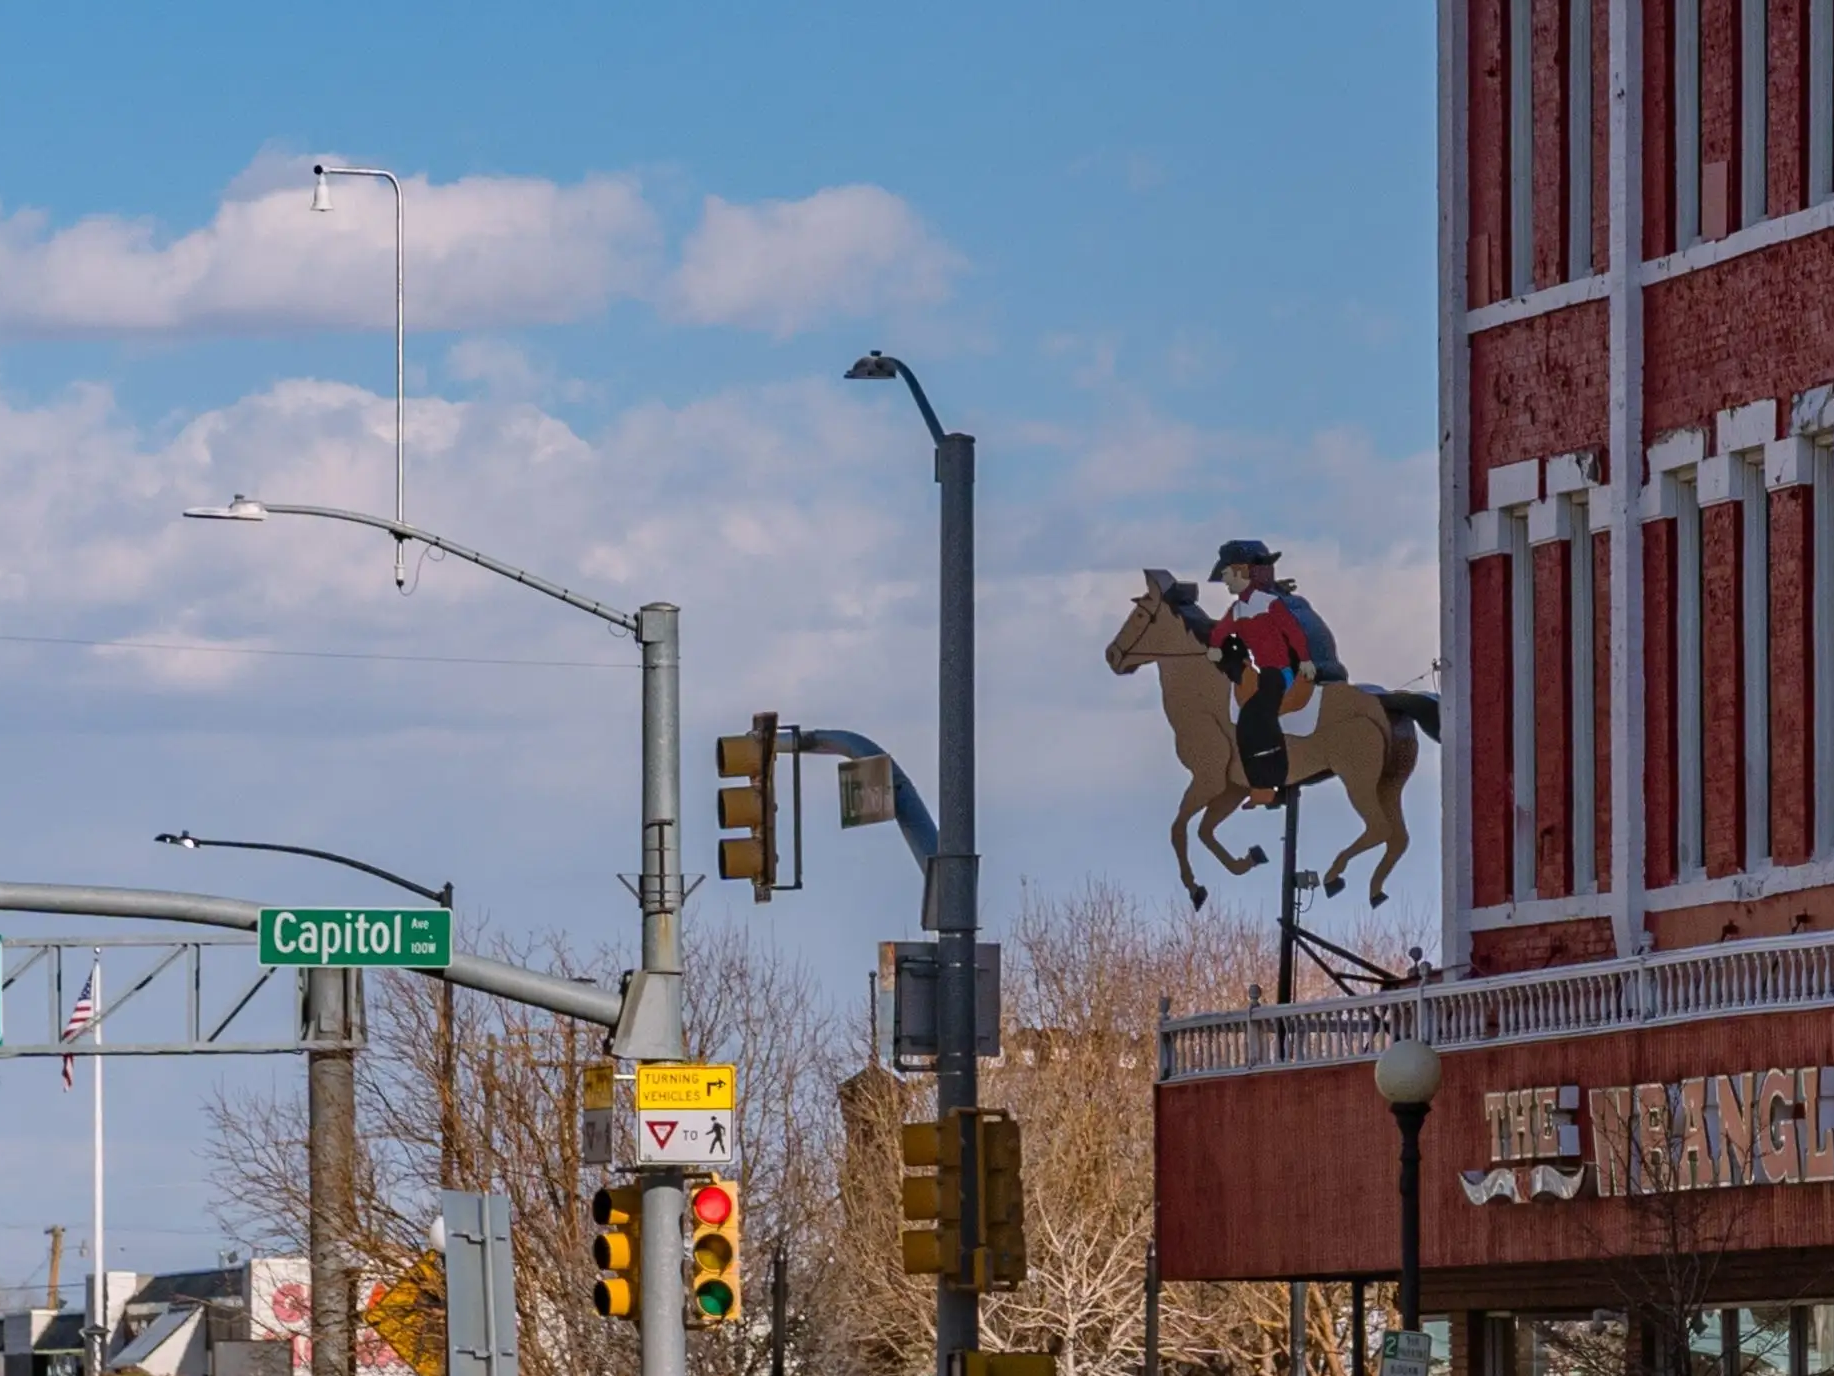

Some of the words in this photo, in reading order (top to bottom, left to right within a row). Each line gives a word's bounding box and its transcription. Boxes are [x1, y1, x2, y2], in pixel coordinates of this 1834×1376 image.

[274, 911, 402, 965] Capitol
[411, 917, 431, 930] Ave
[411, 942, 437, 954] 100W
[645, 1073, 700, 1085] TURNING
[643, 1090, 702, 1102] VEHICLES
[1483, 1085, 1580, 1162] THE
[683, 1130, 699, 1141] TO
[1385, 1335, 1397, 1356] 2
